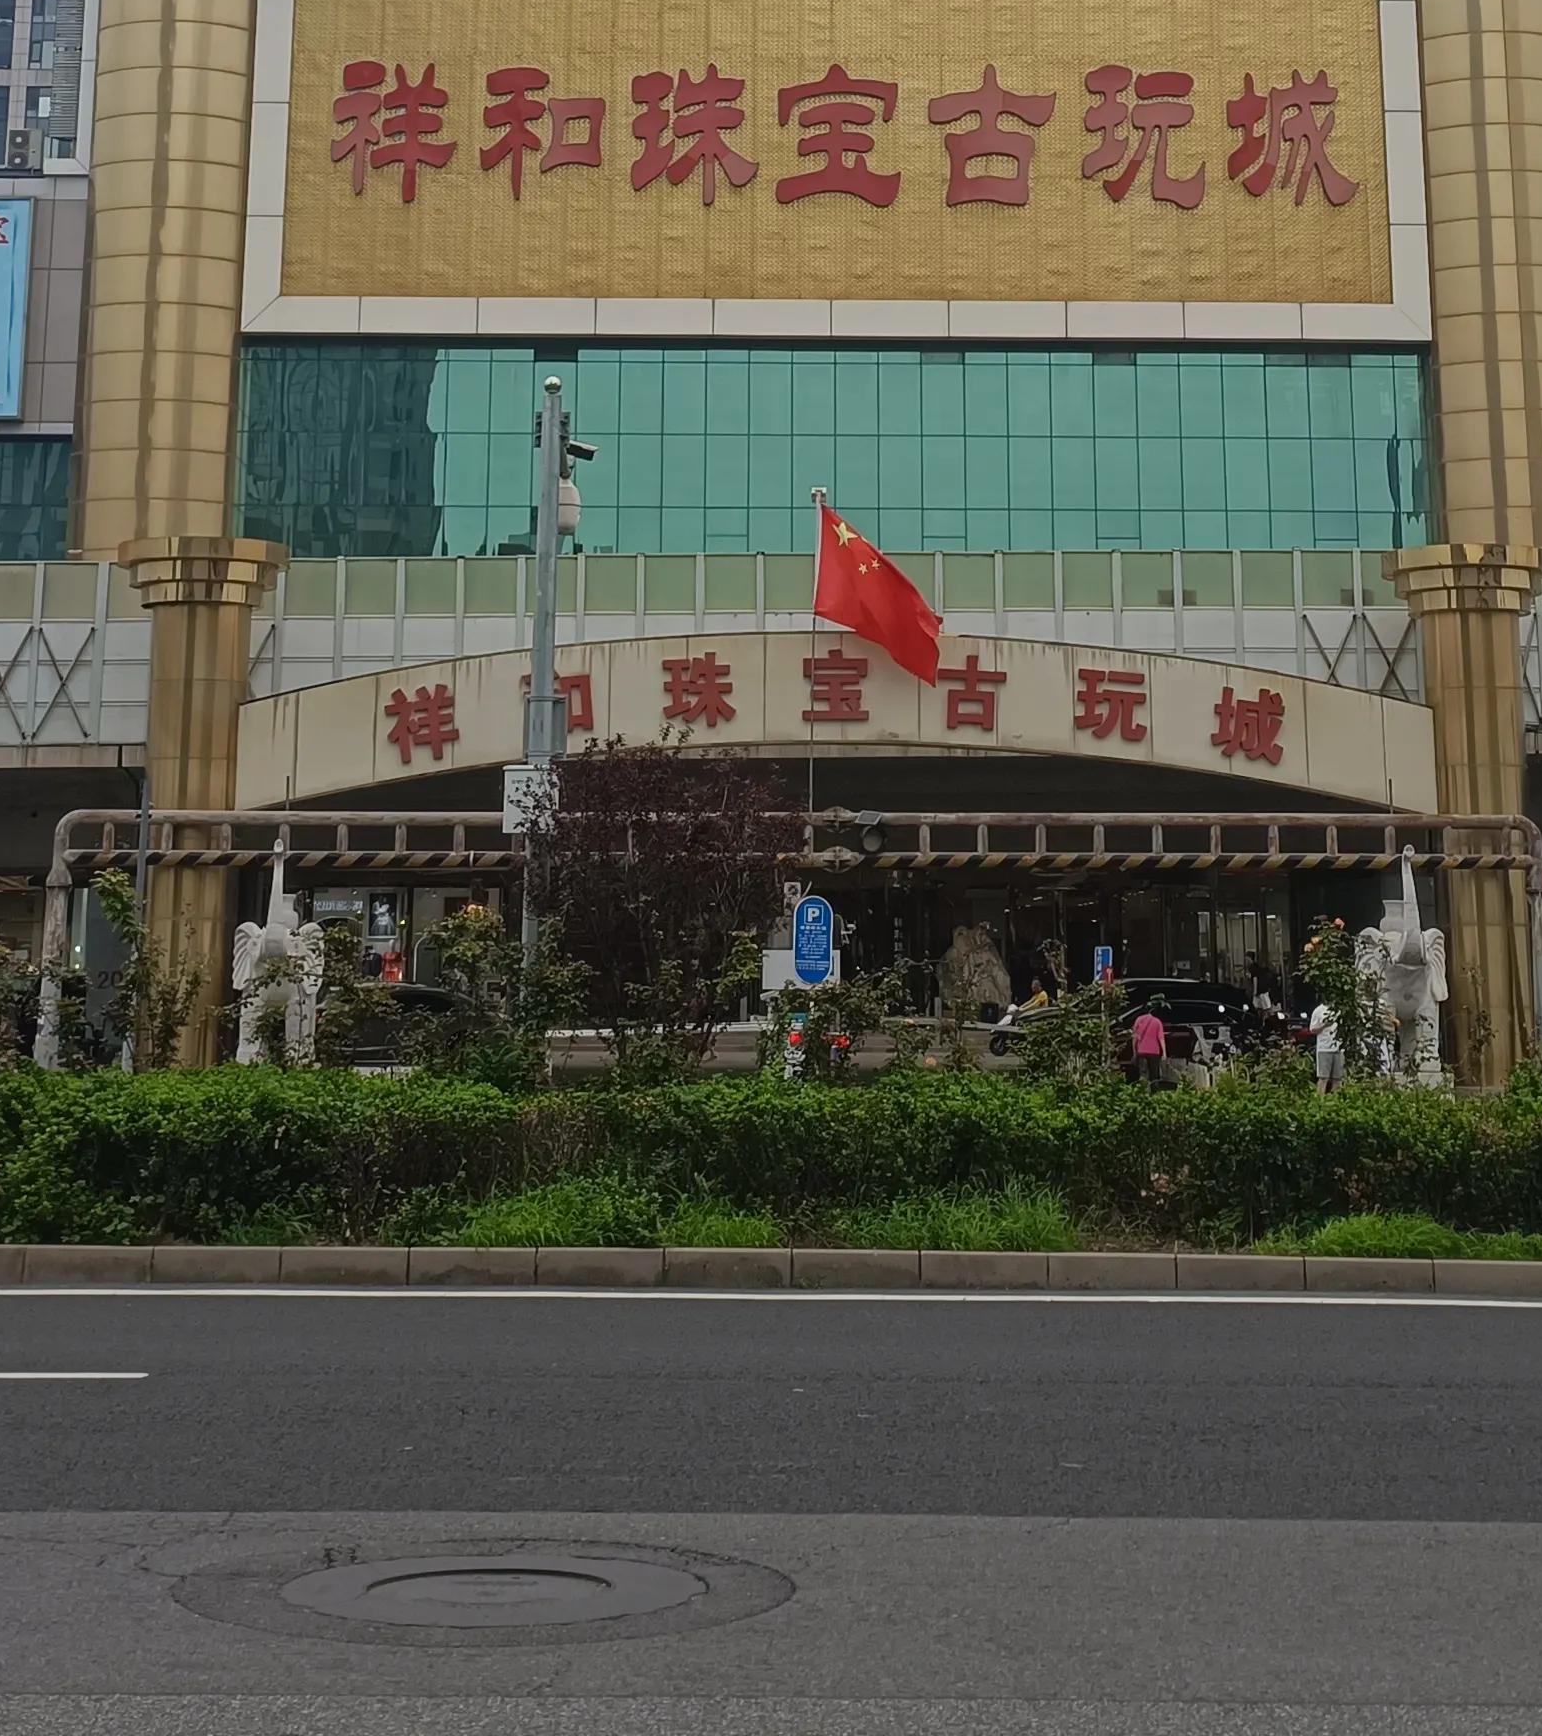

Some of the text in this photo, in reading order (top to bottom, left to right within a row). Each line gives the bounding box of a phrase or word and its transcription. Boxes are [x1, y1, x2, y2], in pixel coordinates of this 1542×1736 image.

[331, 59, 1360, 208] 祥和珠宝古玩城
